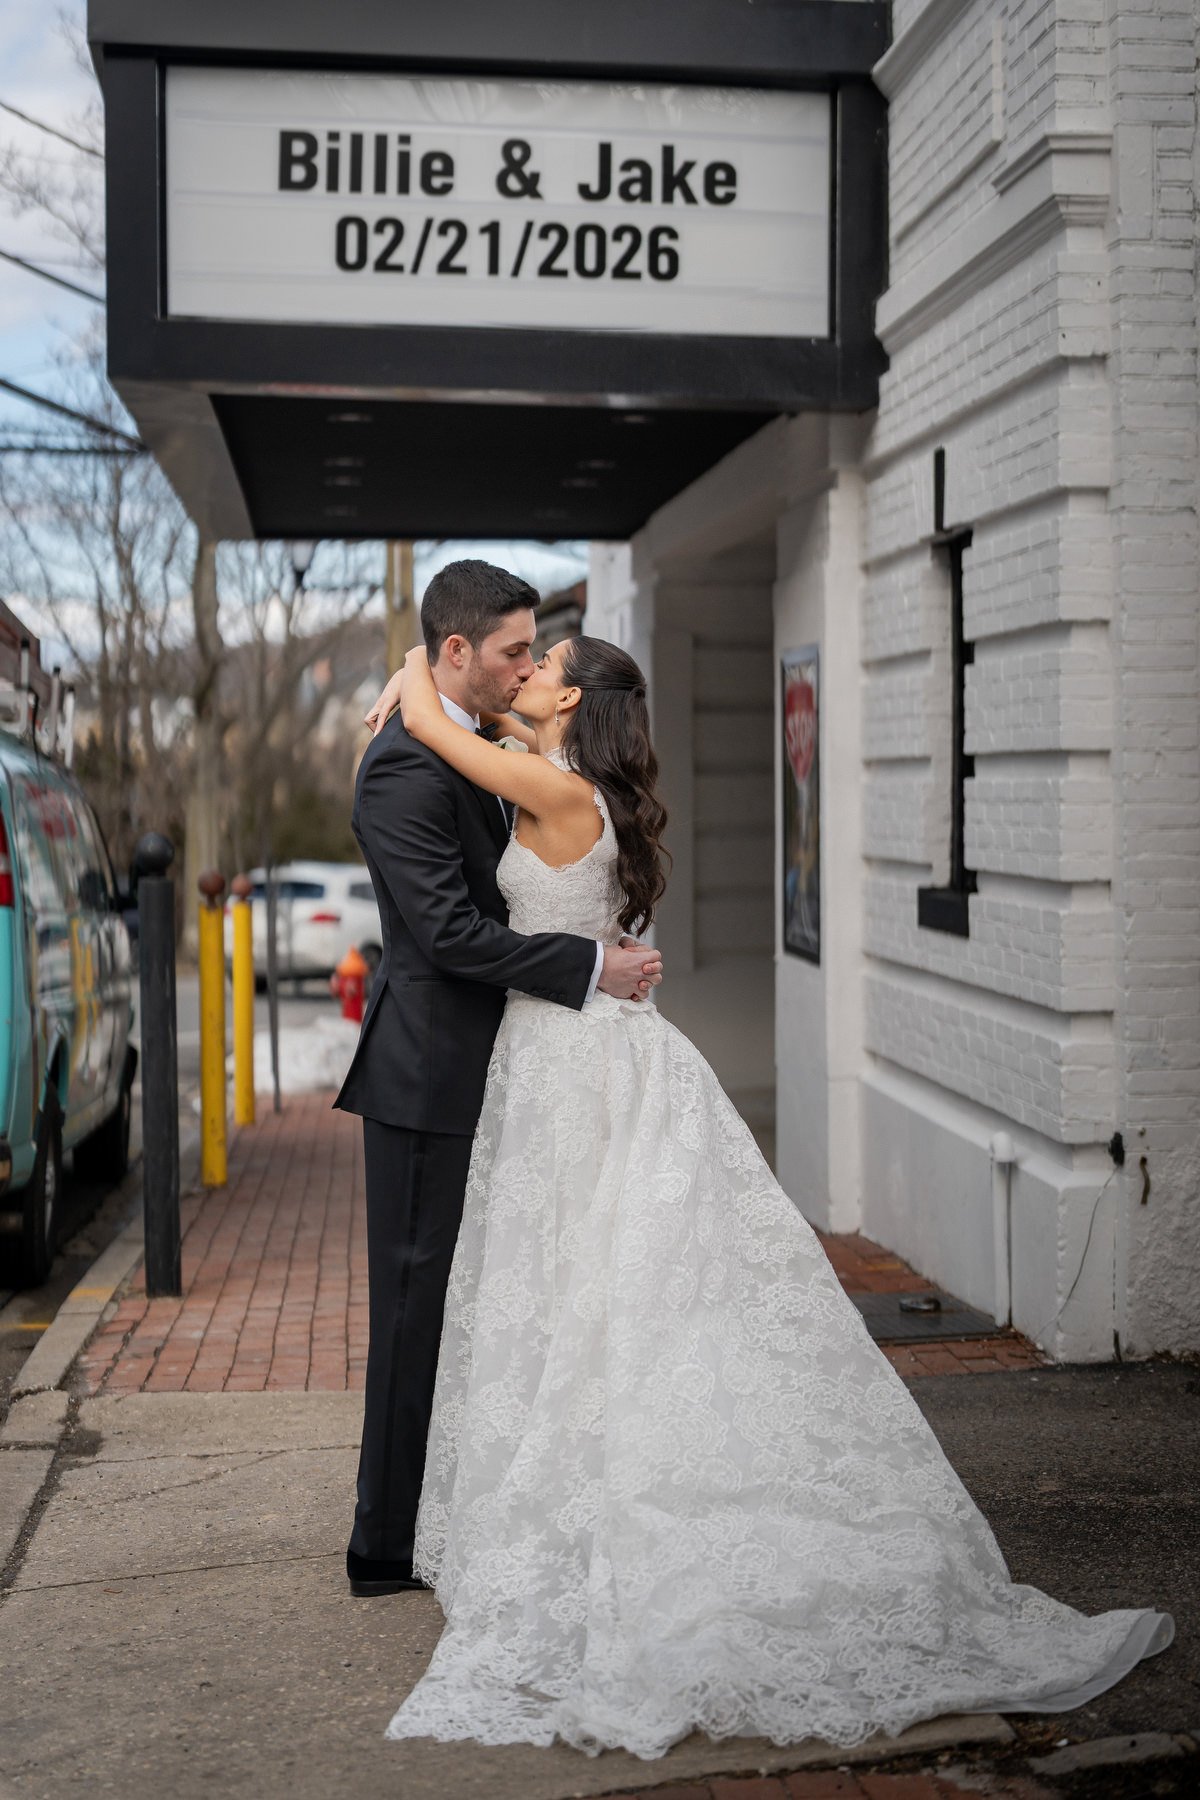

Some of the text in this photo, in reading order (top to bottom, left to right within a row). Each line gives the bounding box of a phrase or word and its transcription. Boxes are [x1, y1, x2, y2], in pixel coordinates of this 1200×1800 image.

[279, 131, 737, 205] Billie & Jake
[336, 216, 680, 281] 02/21/2026
